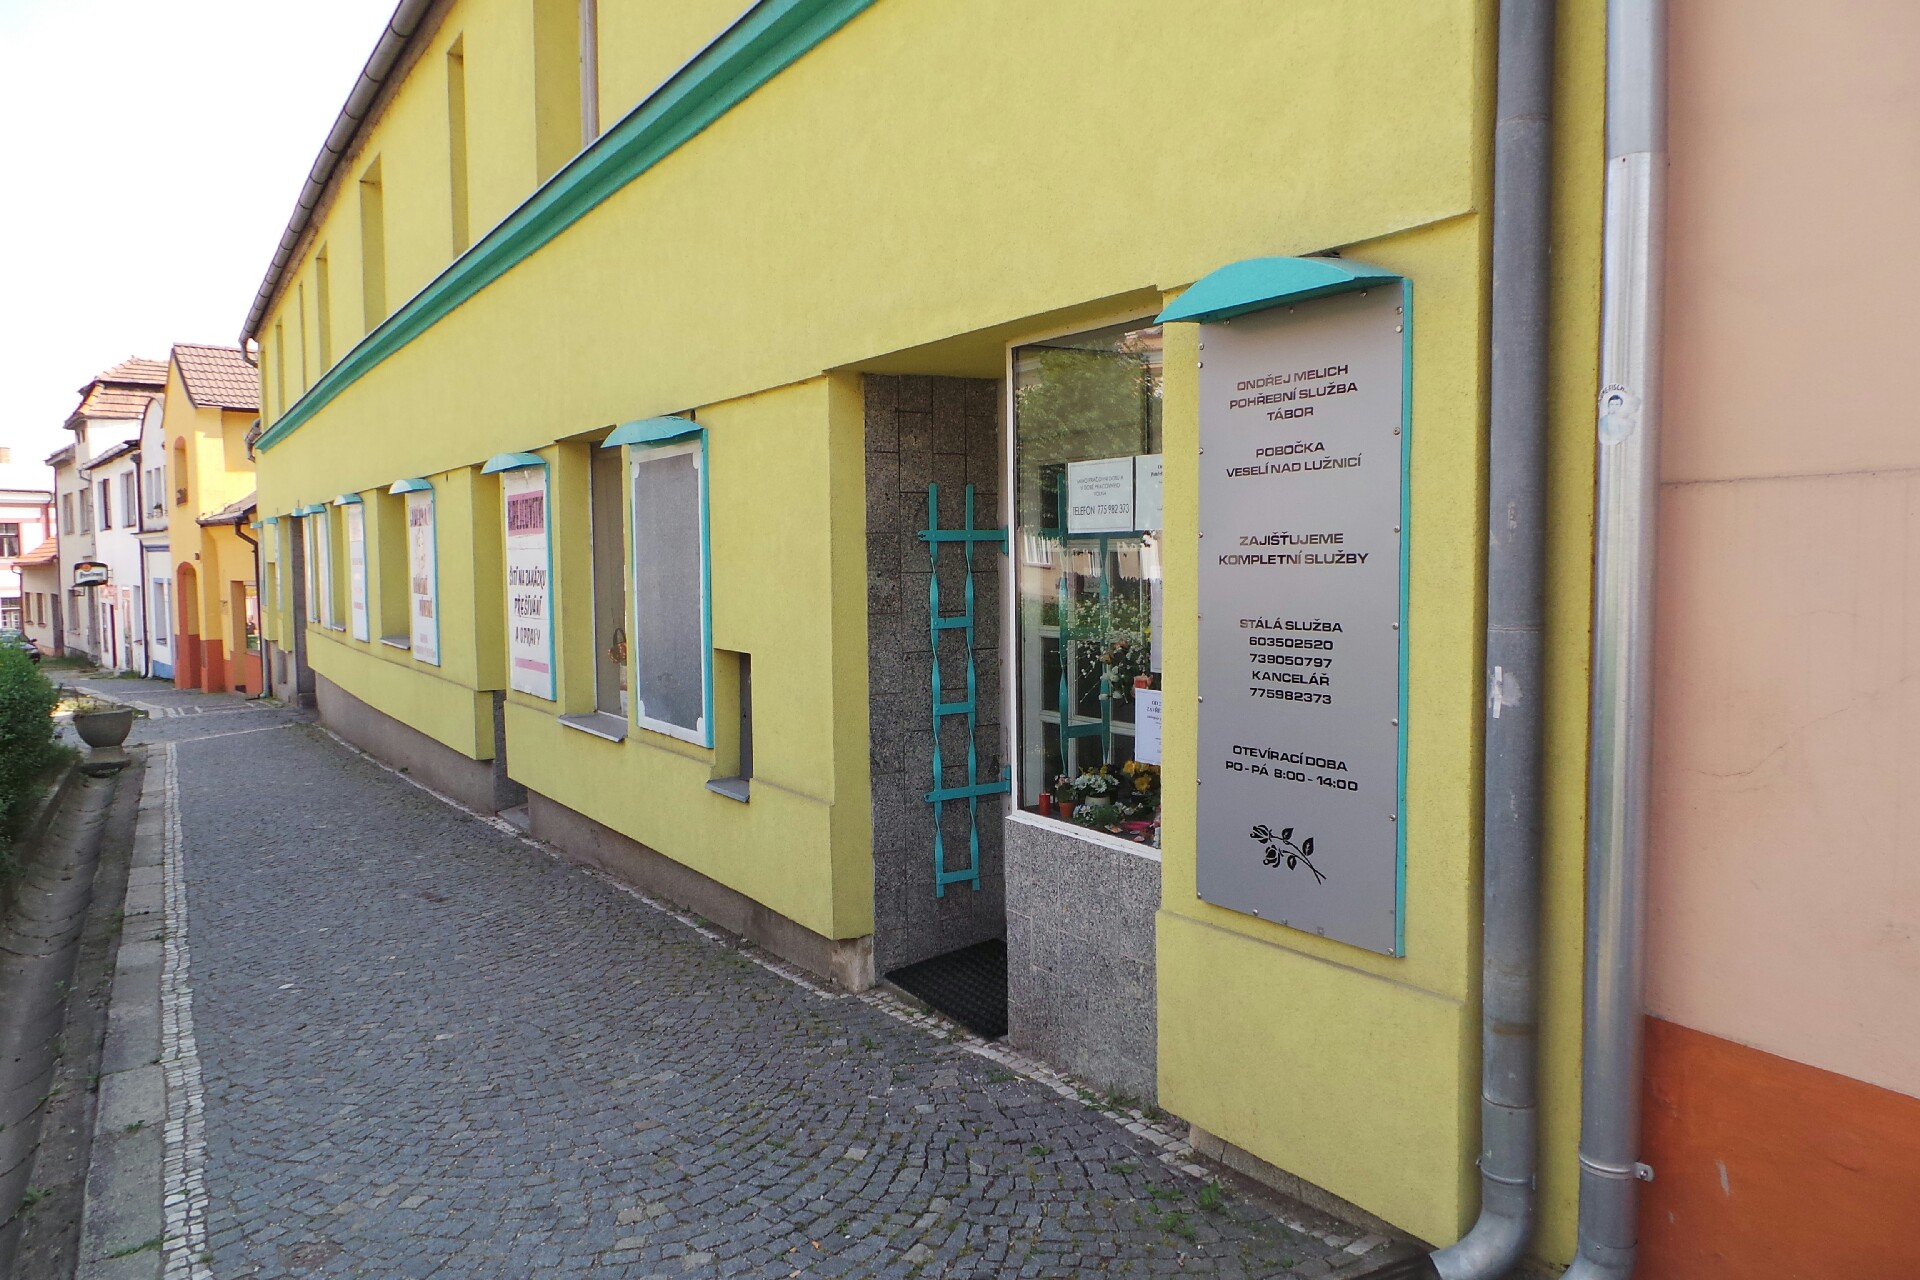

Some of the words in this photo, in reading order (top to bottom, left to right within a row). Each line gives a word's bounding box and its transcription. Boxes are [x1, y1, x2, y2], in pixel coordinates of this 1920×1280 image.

[1236, 373, 1291, 391] ONDŘEJ
[1293, 364, 1349, 383] MELICH
[1229, 387, 1298, 410] POHŘEBNÍ
[1298, 381, 1358, 399] SLUŽBA
[1266, 406, 1314, 422] TÁBOR
[1255, 440, 1325, 458] POBOČKA
[1226, 462, 1270, 478] VESELÍ
[1270, 462, 1301, 474] NAD
[1304, 453, 1363, 471] LUŽNICÍ
[1073, 506, 1095, 516] TELEFON
[1097, 504, 1107, 515] 775
[1108, 504, 1118, 514] 982
[1119, 503, 1130, 514] 373
[1239, 531, 1344, 546] ZAJIŠŤUJEME
[1218, 550, 1303, 565] KOMPLETNÍ
[1304, 550, 1369, 565] SLUŽBY
[514, 593, 543, 617] PŘEŠÍVÁNÍ
[1239, 617, 1283, 630] STÁLÁ
[1285, 618, 1343, 633] SLUŽBA
[1249, 636, 1334, 651] 603502520
[1249, 653, 1333, 669] 739050797
[1252, 670, 1330, 686] KANCELÁŘ
[1249, 687, 1332, 704] 775982373
[1232, 744, 1305, 765] OTEVÍRACÍ
[1305, 755, 1348, 772] DOBA
[1274, 767, 1305, 783] 8:00
[1316, 775, 1358, 792] 14:00
